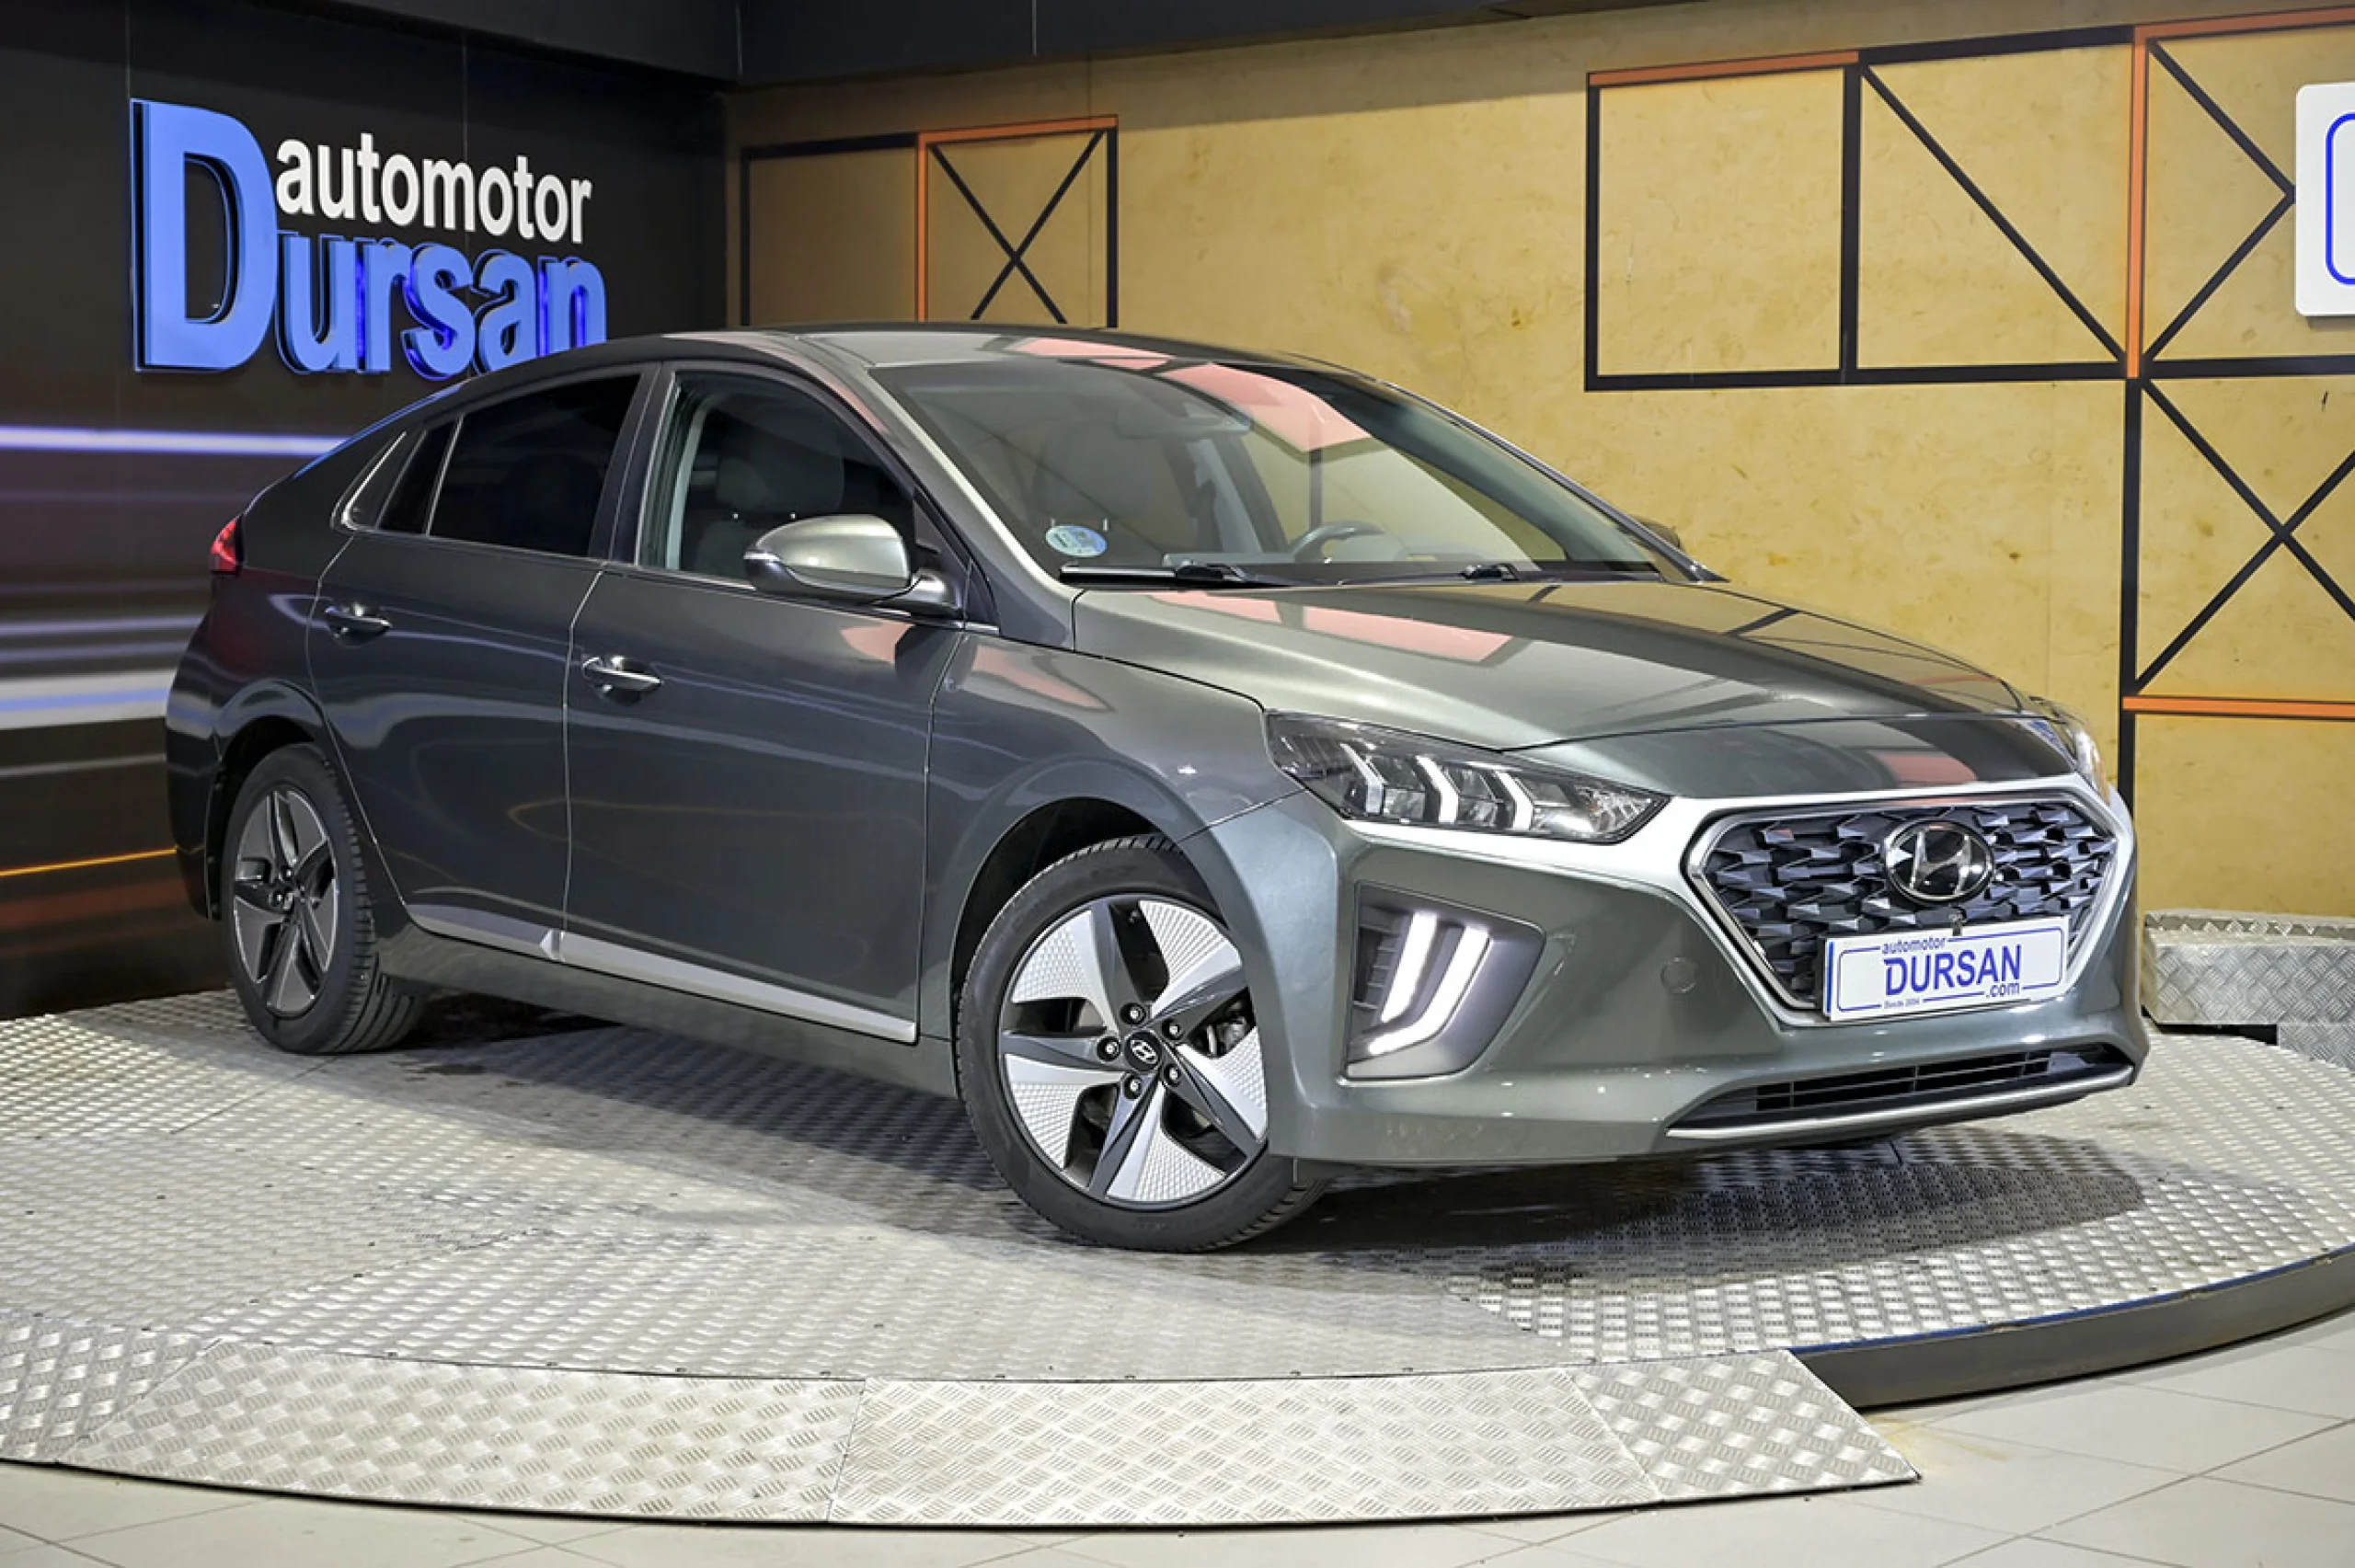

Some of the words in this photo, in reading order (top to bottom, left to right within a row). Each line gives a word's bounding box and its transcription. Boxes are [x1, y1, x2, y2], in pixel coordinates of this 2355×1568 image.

[276, 132, 592, 244] automotor
[131, 97, 607, 379] Dursan
[1882, 937, 1947, 954] automotor
[1883, 944, 2022, 995] DURSAN
[1985, 982, 2020, 999] .com
